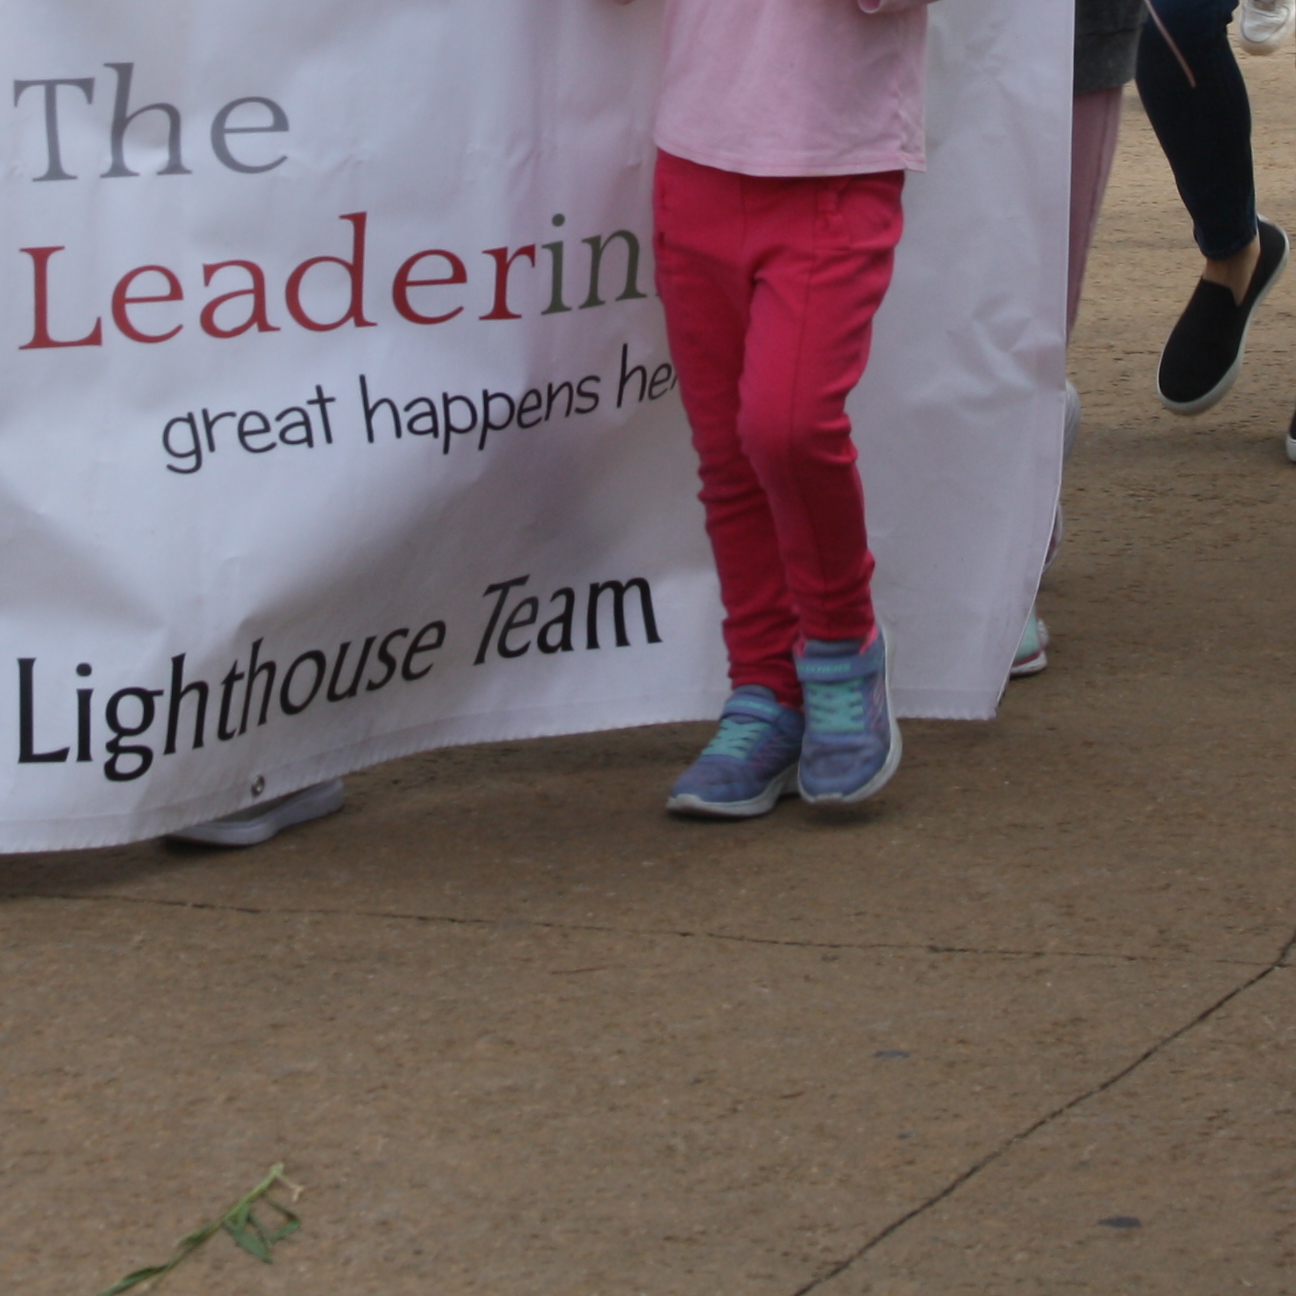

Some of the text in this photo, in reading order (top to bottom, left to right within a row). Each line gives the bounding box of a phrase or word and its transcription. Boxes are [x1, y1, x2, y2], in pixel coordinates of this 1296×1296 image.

[13, 62, 290, 182] The
[161, 384, 337, 475] great
[358, 373, 601, 456] happens
[16, 572, 664, 783] Lighthouse Team
